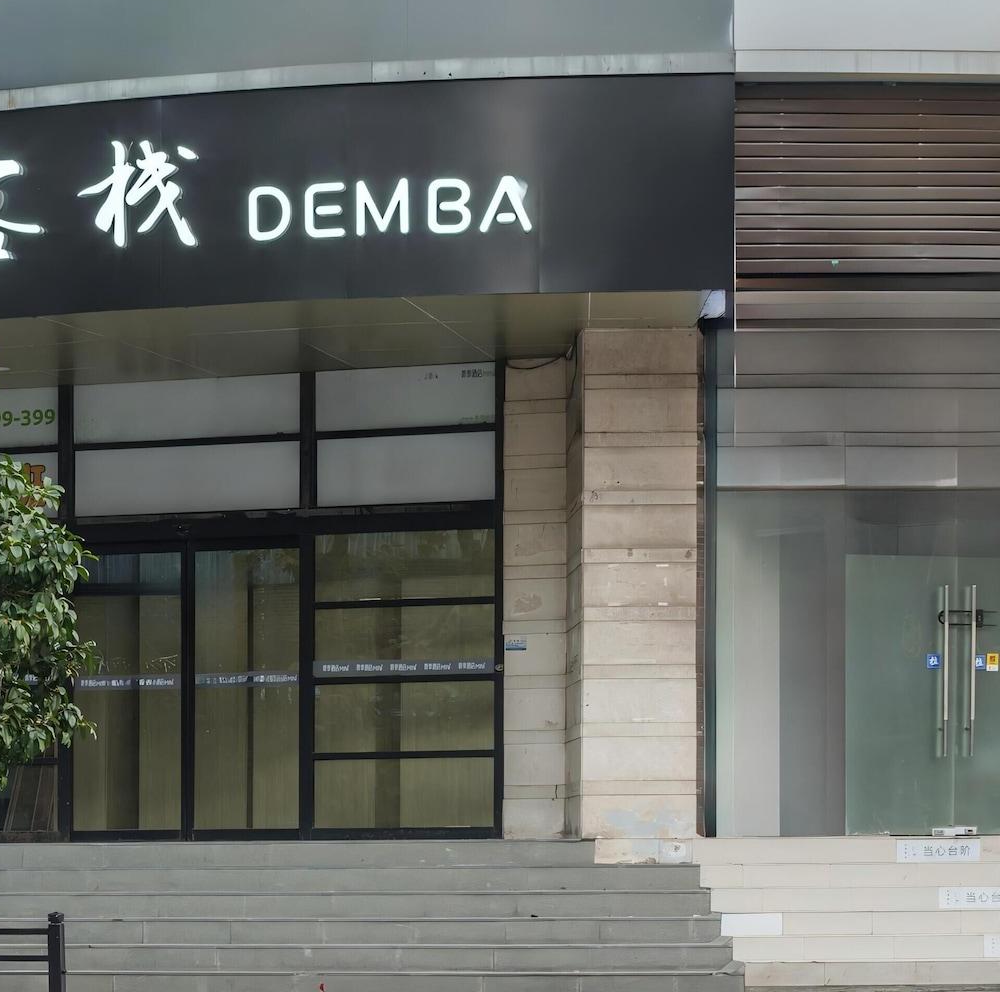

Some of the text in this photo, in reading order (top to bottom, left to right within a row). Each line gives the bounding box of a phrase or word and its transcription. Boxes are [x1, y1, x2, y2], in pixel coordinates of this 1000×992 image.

[248, 175, 533, 241] DEMBA
[923, 845, 970, 857] 当心台阶
